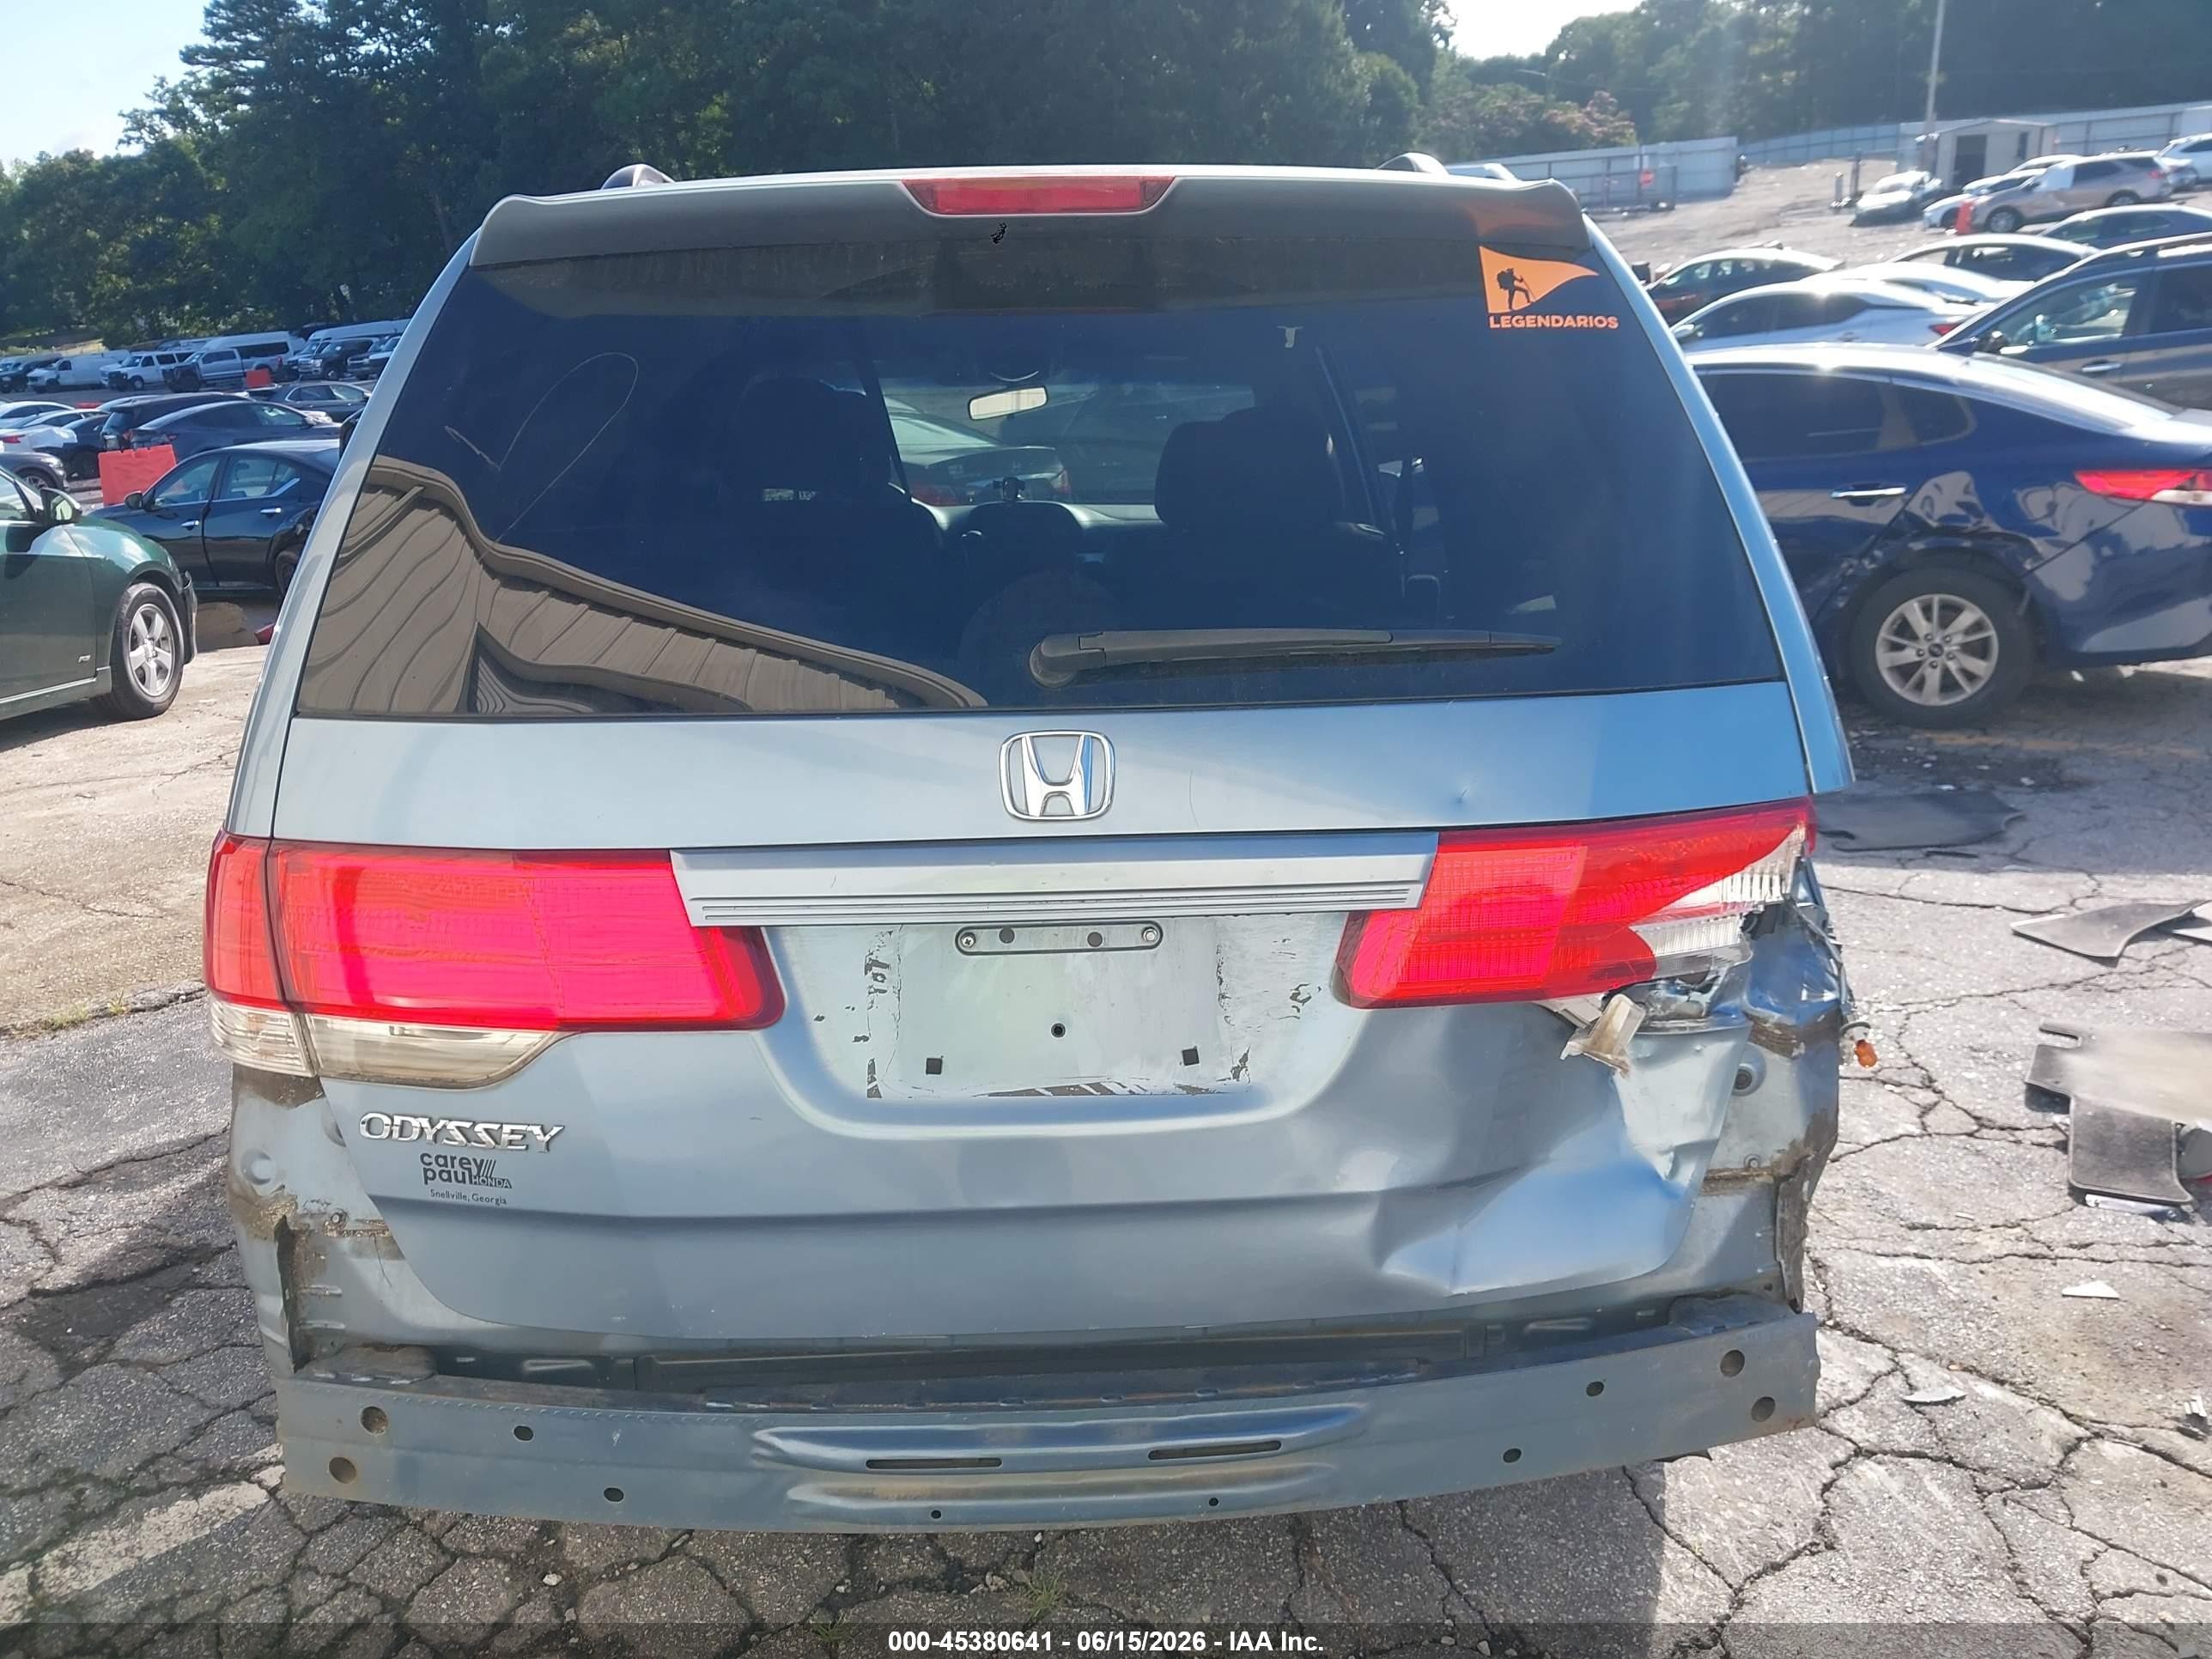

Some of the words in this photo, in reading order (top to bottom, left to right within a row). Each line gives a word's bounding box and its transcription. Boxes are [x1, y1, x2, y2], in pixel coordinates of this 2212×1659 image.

[1489, 315, 1619, 330] LEGENDARIOS
[359, 1112, 565, 1152] ODYSSEY
[420, 1152, 483, 1177] carey
[422, 1168, 472, 1185] paul
[472, 1176, 512, 1188] HONDA
[430, 1189, 470, 1202] Snellville,
[472, 1194, 507, 1206] Georgia
